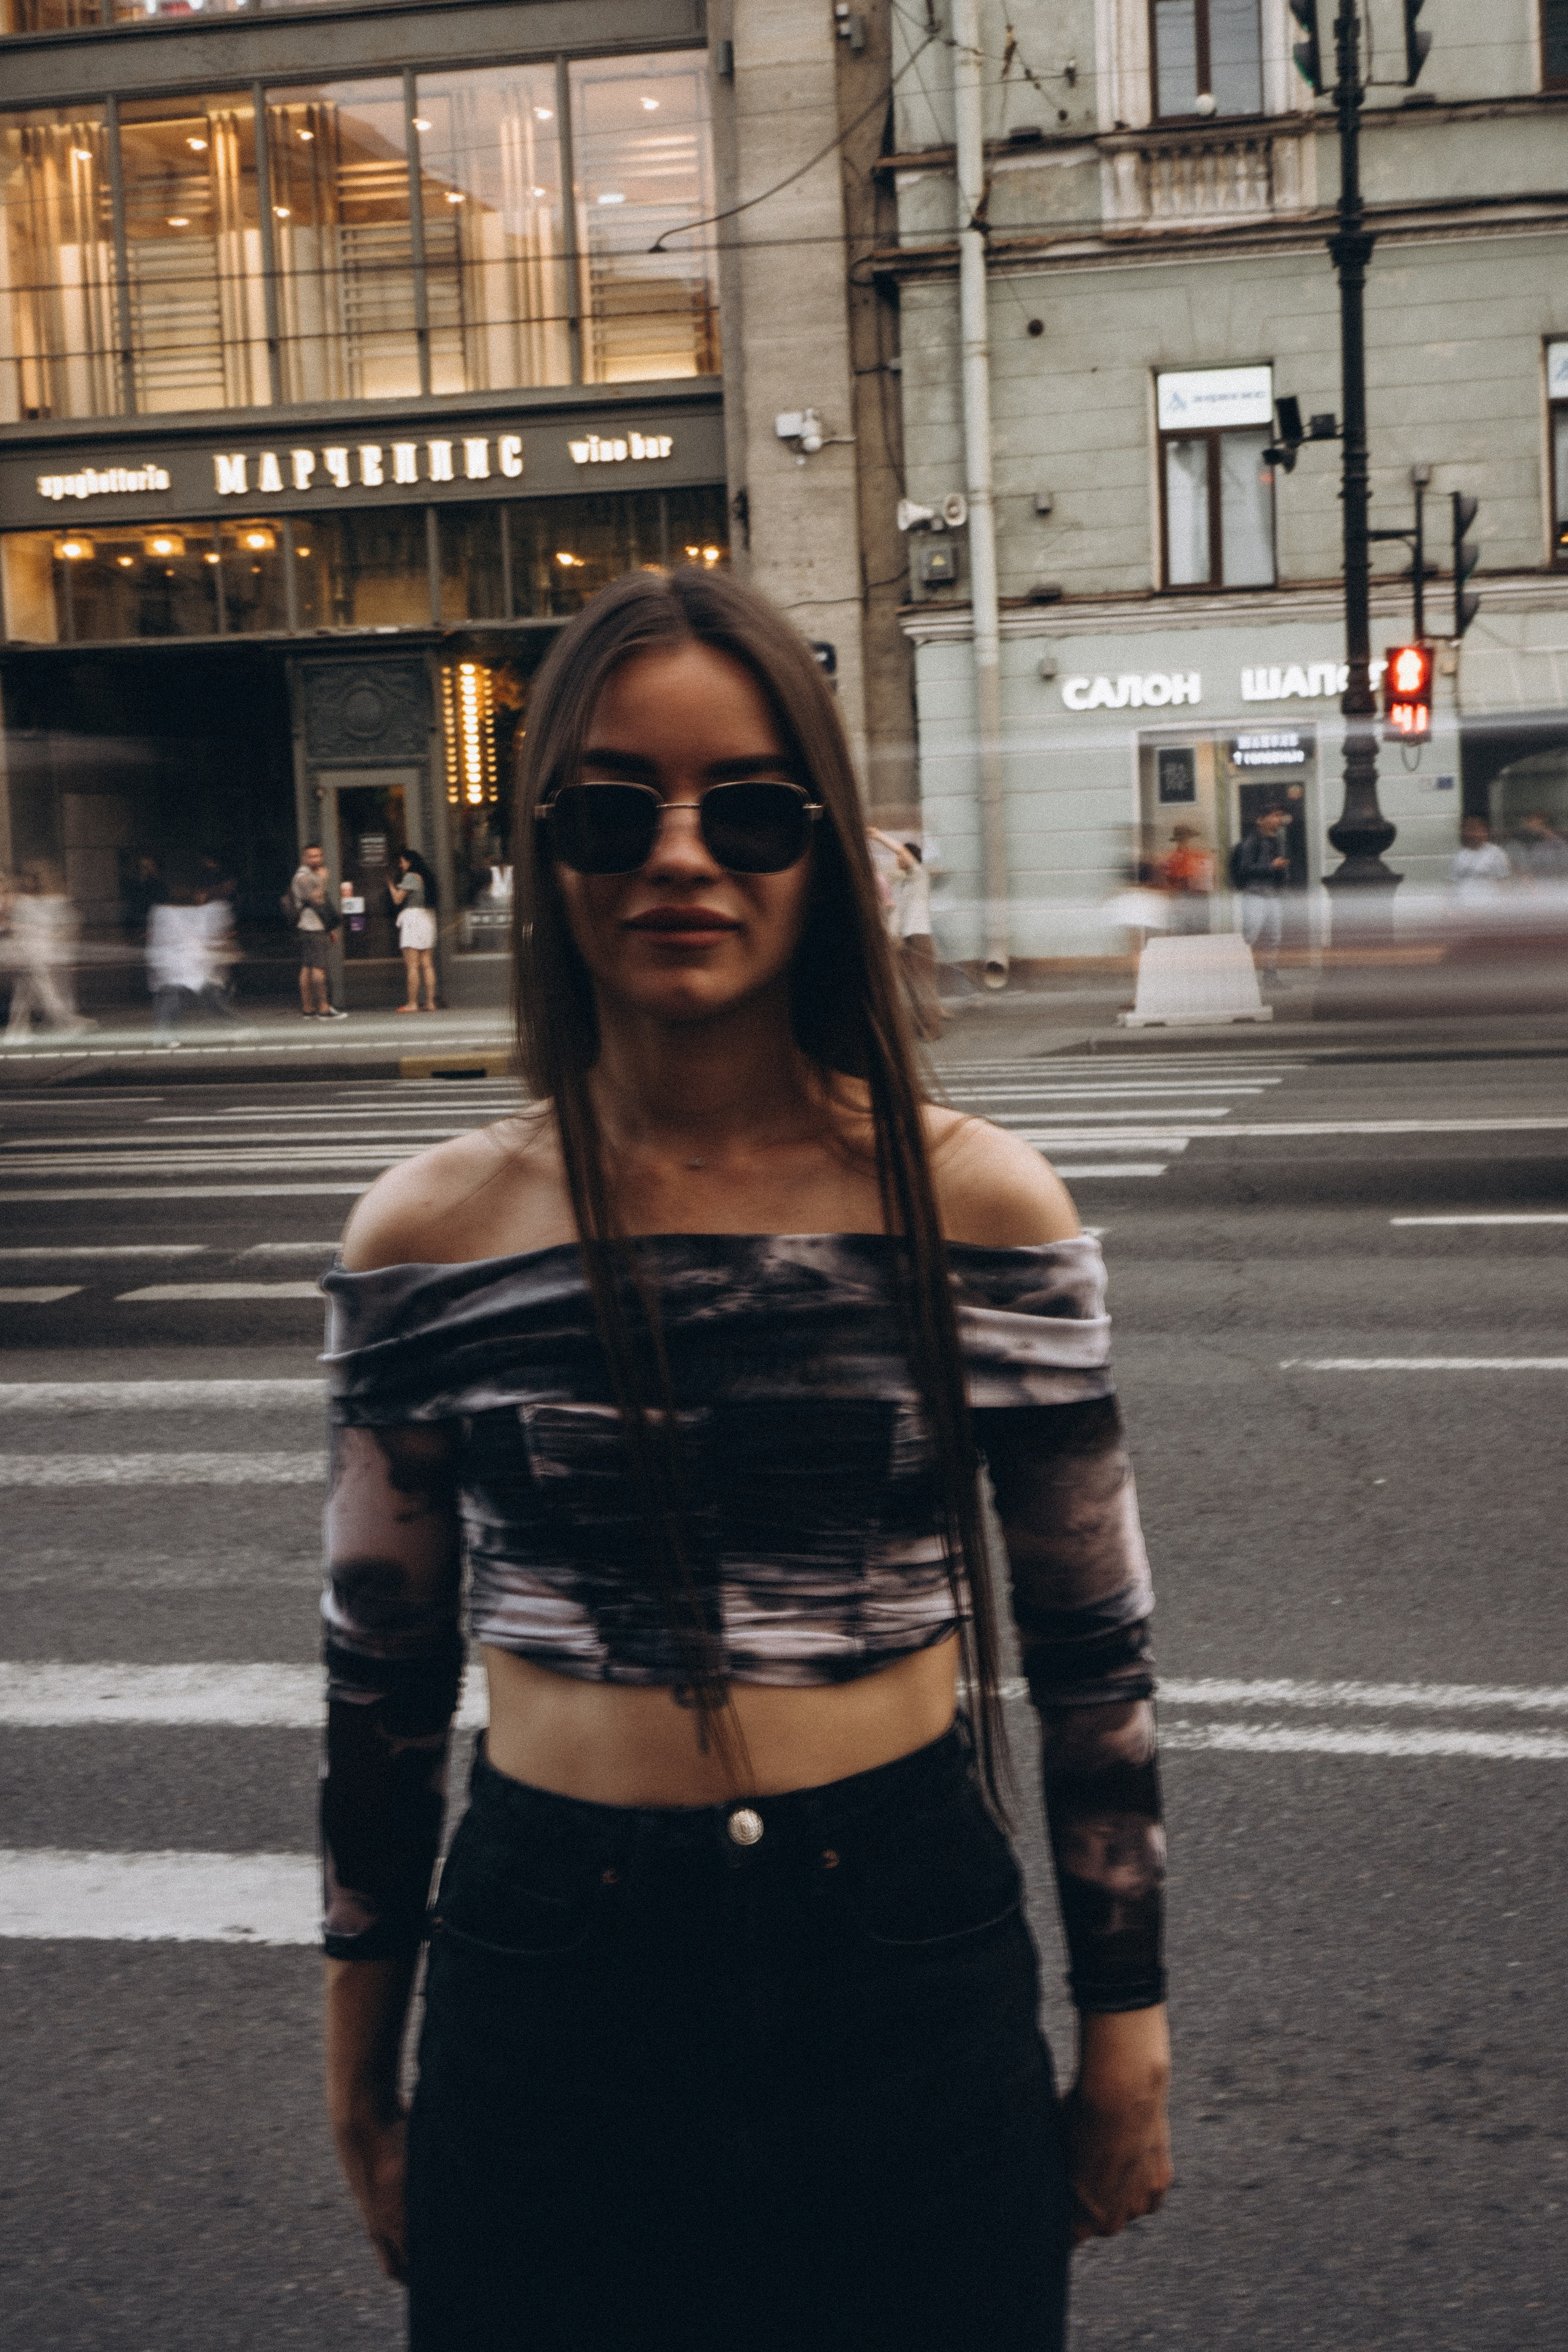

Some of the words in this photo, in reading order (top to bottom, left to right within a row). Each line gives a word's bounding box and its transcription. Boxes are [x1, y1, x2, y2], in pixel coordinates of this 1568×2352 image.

[568, 435, 628, 464] vino
[628, 431, 673, 459] bar
[1062, 673, 1202, 710] САЛОН
[1392, 703, 1428, 734] 41
